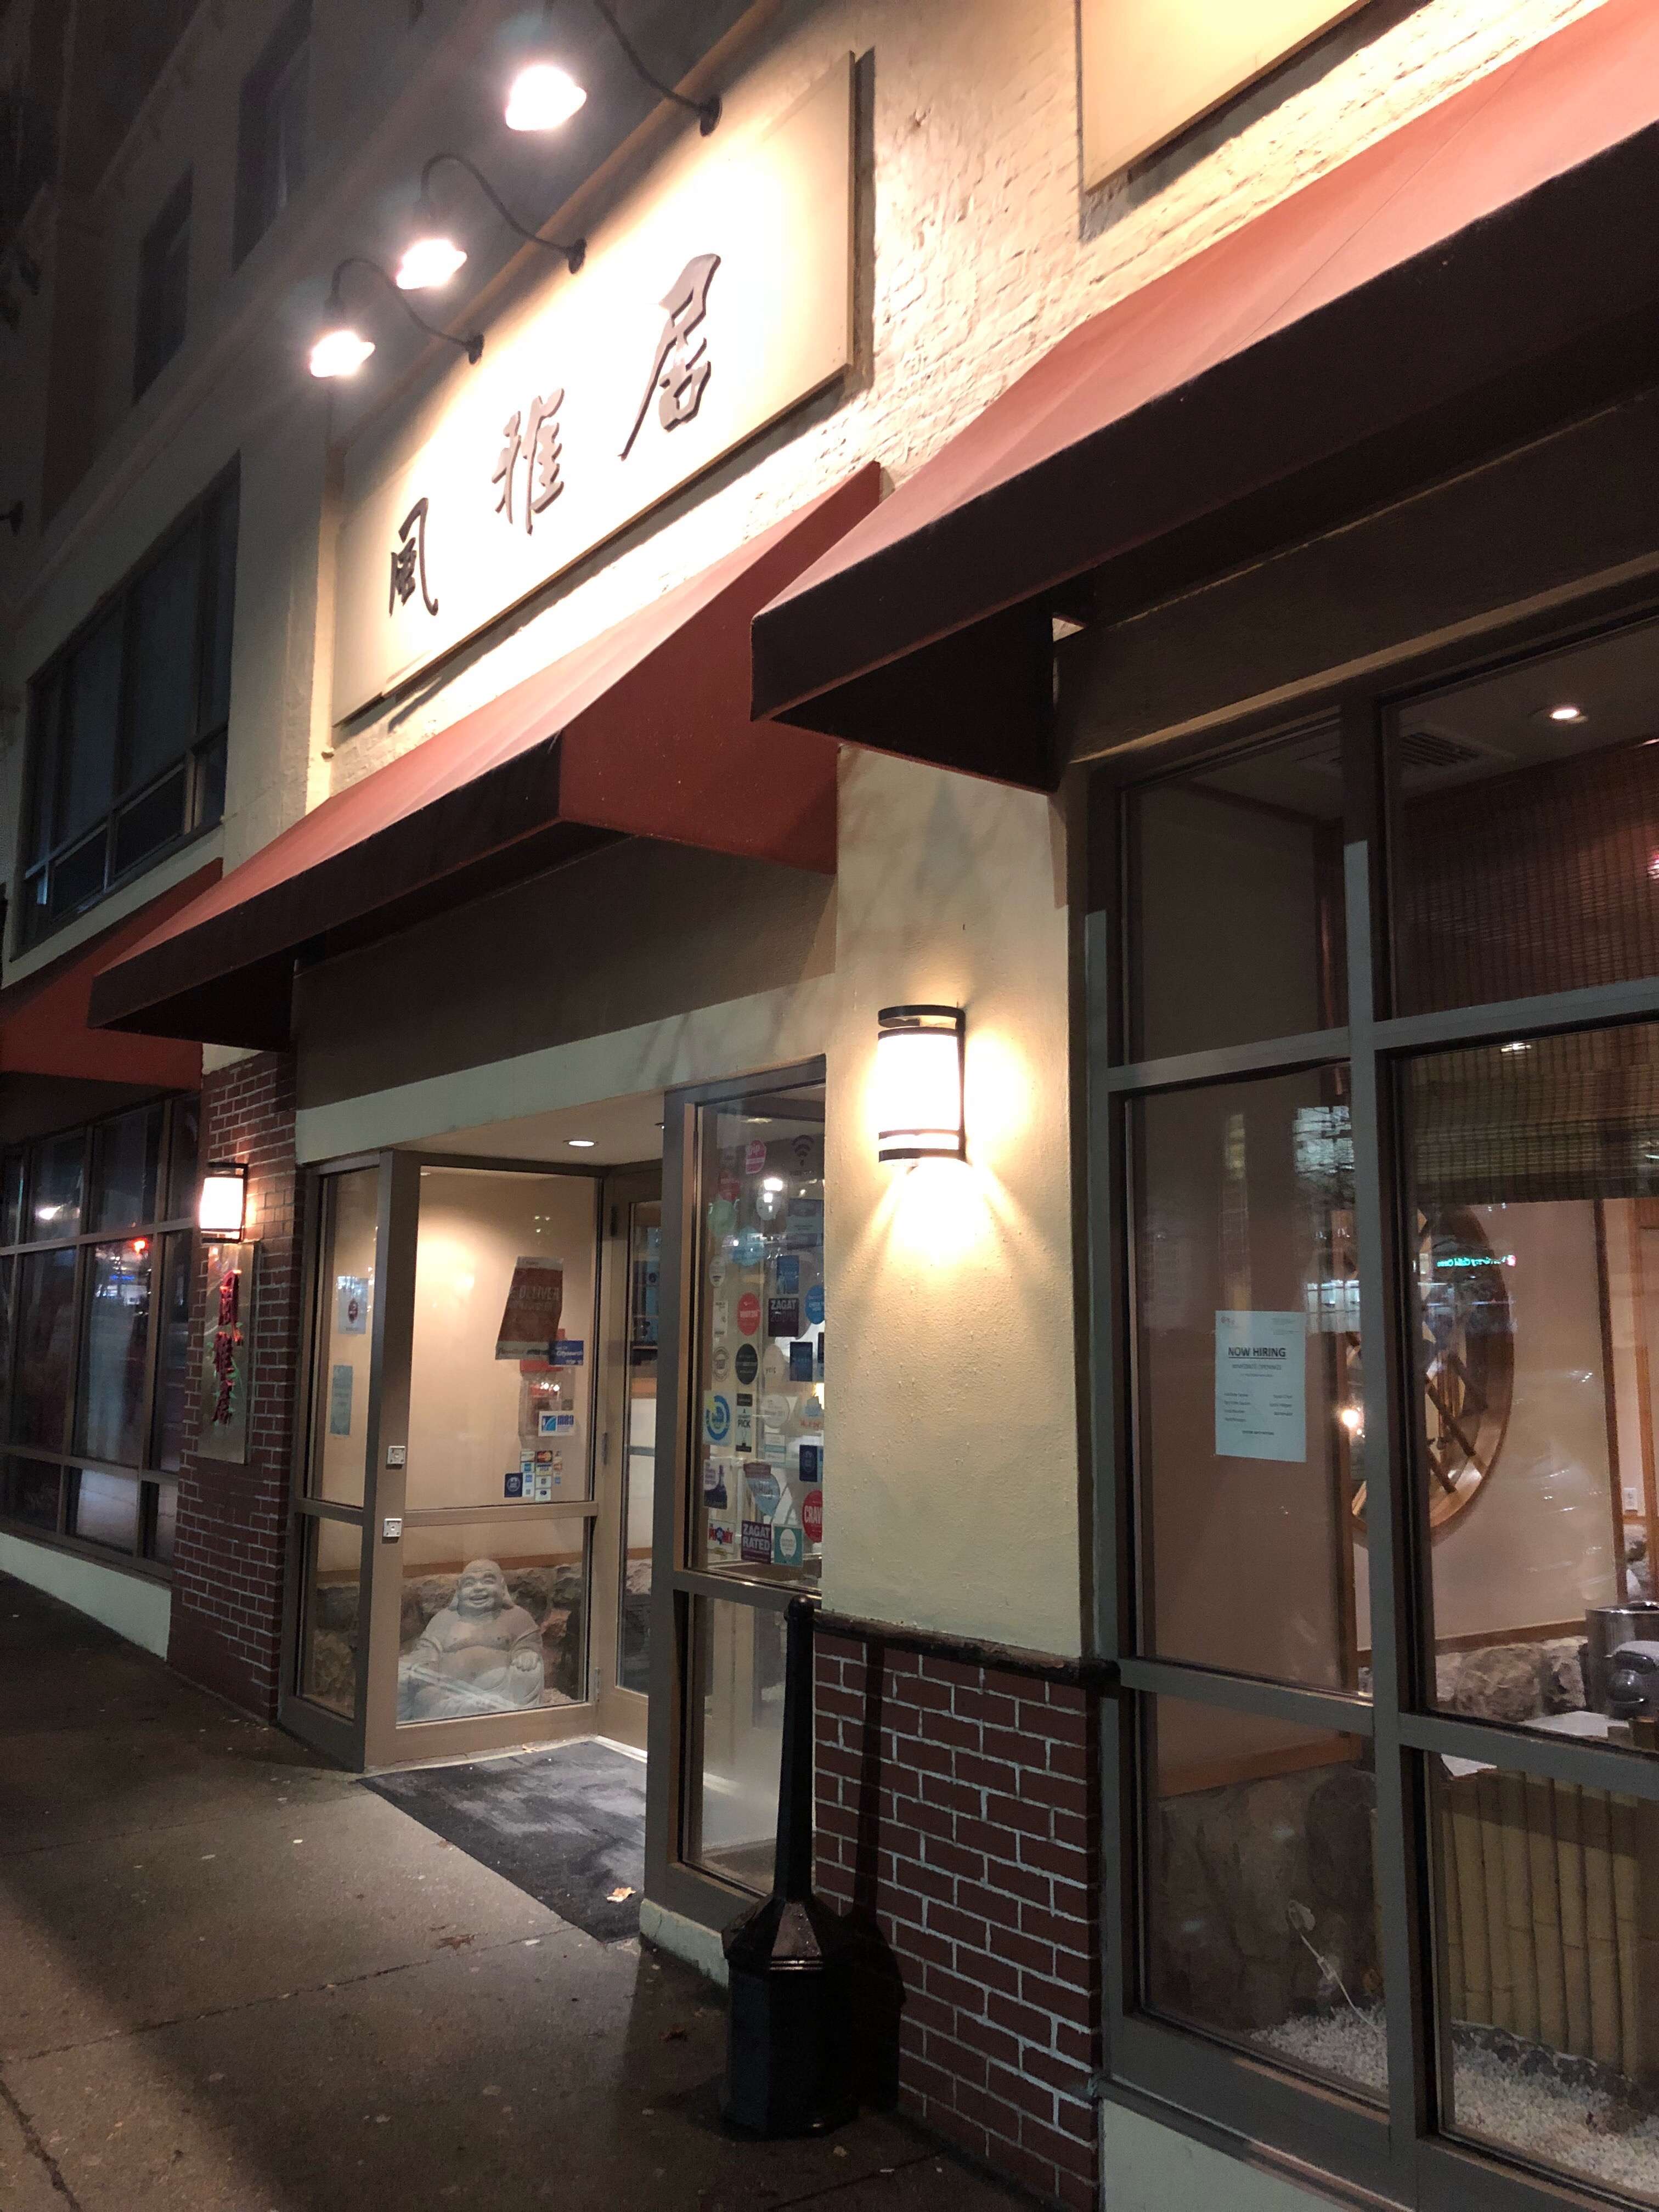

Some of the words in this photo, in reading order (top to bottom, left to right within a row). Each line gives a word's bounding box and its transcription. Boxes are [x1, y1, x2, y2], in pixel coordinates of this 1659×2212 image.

[771, 1300, 796, 1310] ZAGAT
[1228, 1347, 1250, 1356] NOW
[1253, 1347, 1286, 1357] HIRING
[737, 1419, 751, 1428] PICK
[804, 1505, 822, 1523] CRAV
[743, 1523, 769, 1538] ZAGAT
[743, 1537, 770, 1551] RATED
